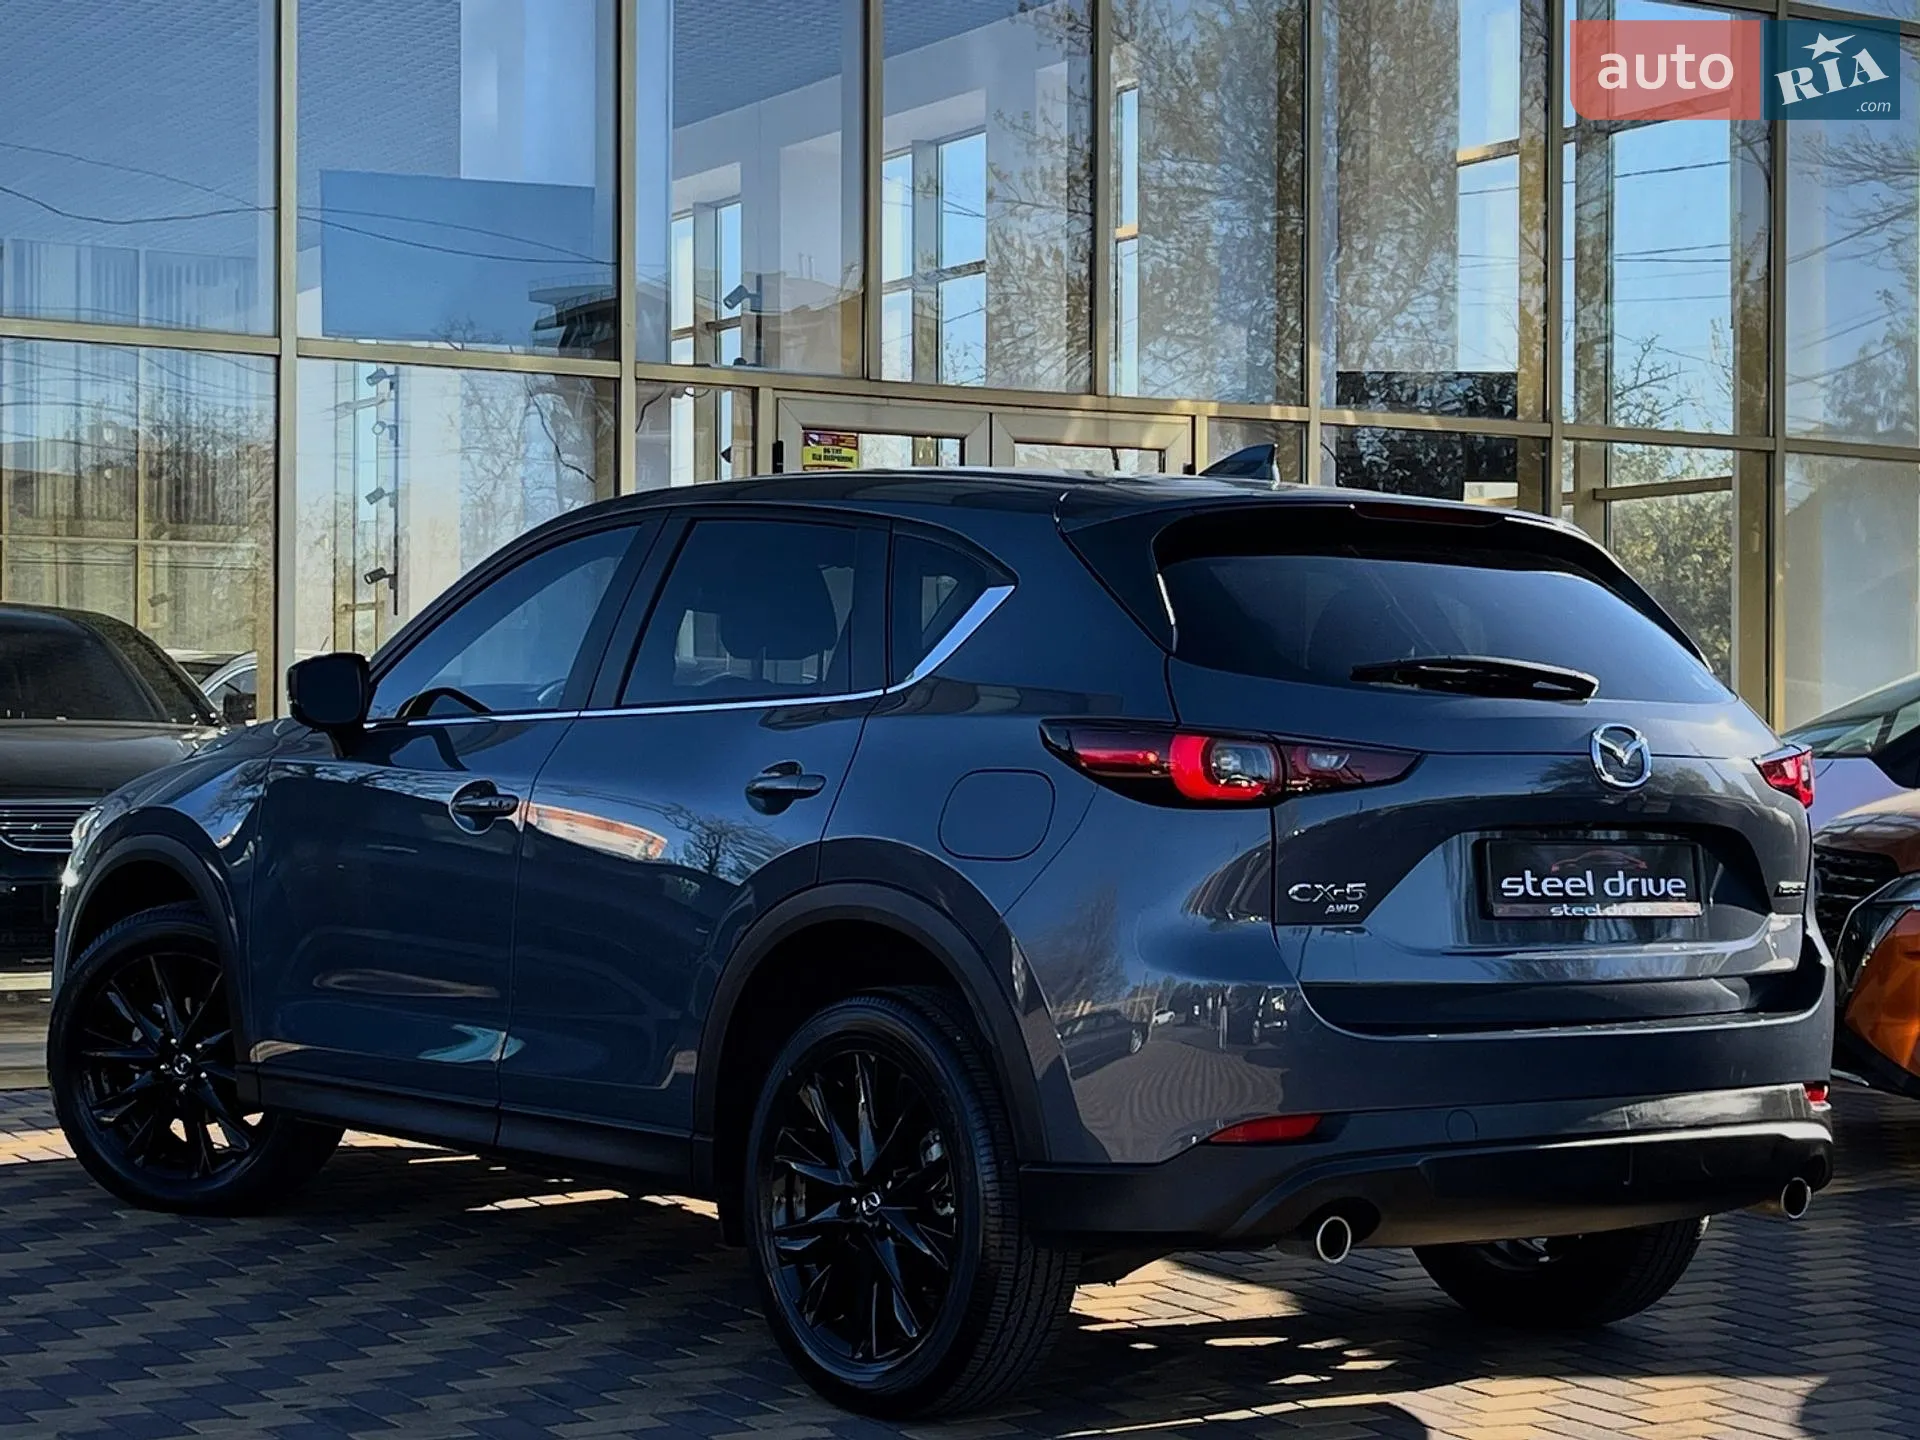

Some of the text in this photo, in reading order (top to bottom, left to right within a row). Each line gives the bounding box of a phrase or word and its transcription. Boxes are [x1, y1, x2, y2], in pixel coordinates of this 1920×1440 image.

[1287, 882, 1367, 903] CX-5
[1501, 870, 1687, 897] steel drive
[1324, 904, 1360, 915] AWD
